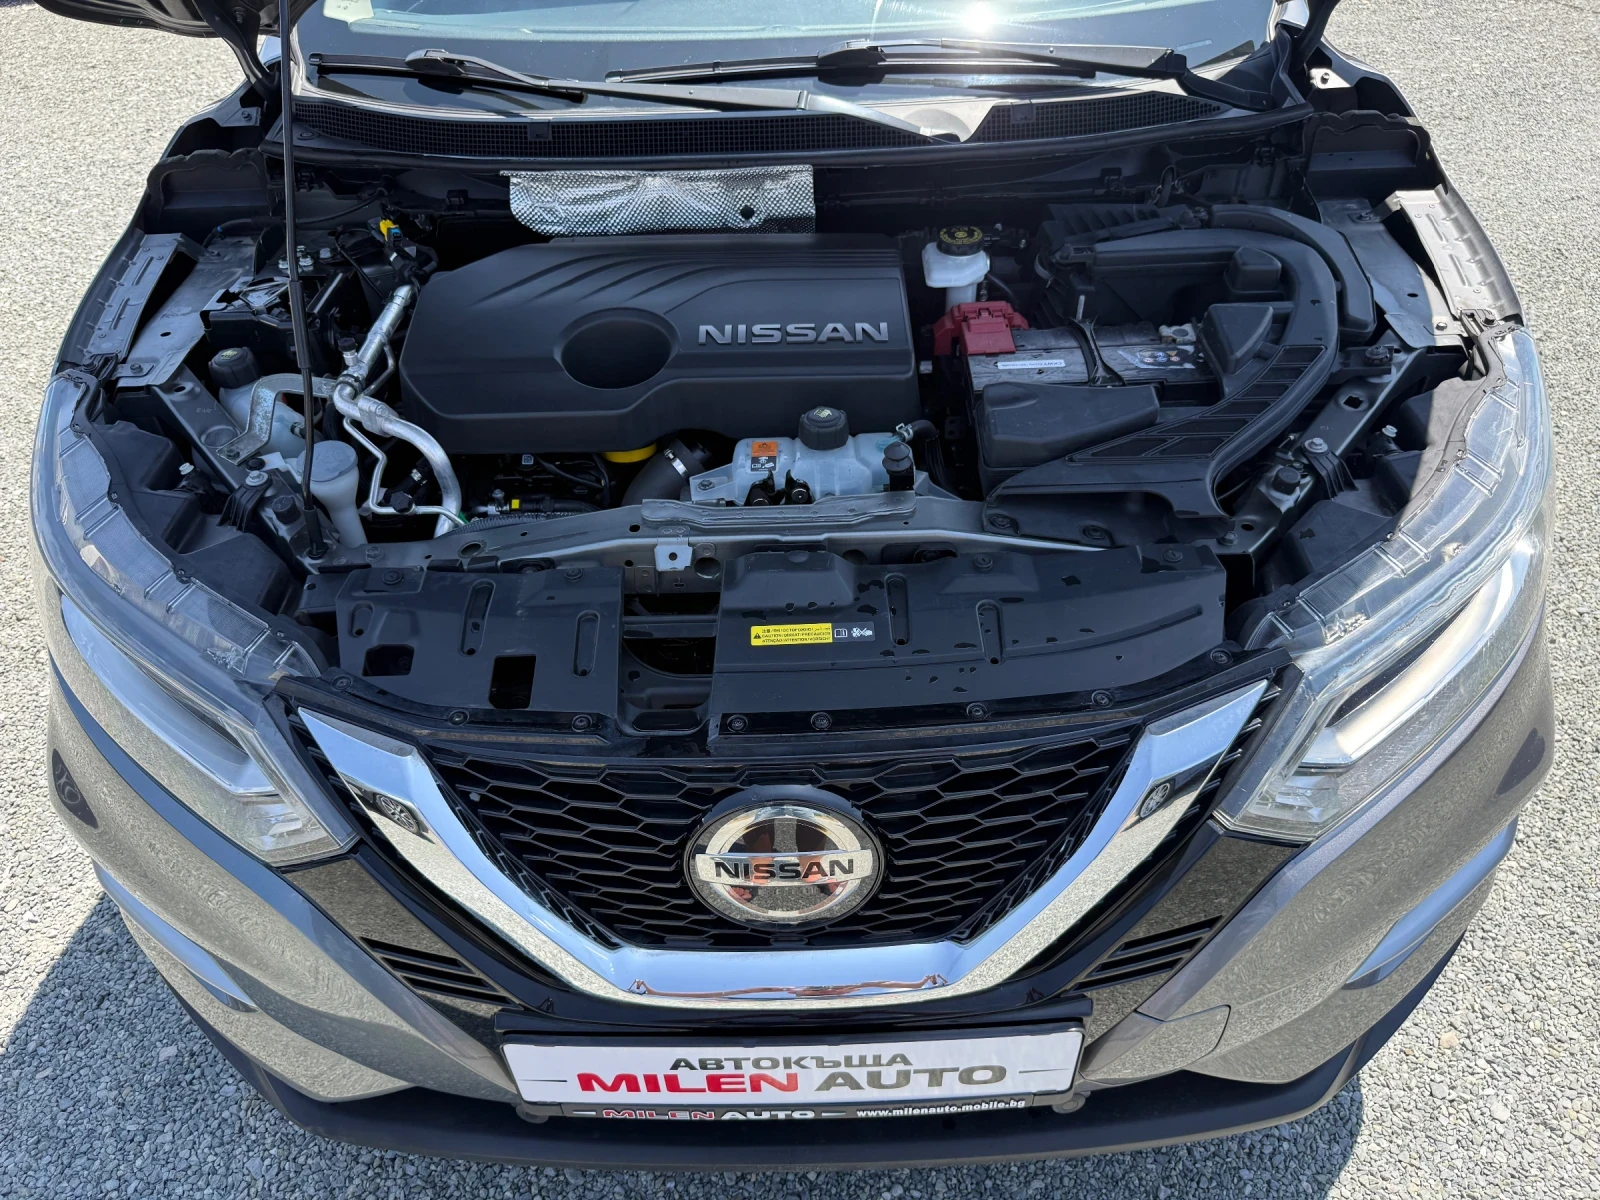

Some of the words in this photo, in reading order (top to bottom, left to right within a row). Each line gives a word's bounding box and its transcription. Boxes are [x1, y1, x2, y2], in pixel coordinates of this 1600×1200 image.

[698, 322, 889, 344] NISSAN
[714, 858, 854, 880] NISSAN
[669, 1053, 914, 1071] АВТОКЪЩА
[576, 1072, 799, 1093] MILEN
[814, 1064, 1007, 1092] AUTO
[602, 1109, 716, 1120] MILEN
[720, 1109, 815, 1120] AUTO
[856, 1099, 1026, 1118] www.milenauto.mobile.bg
